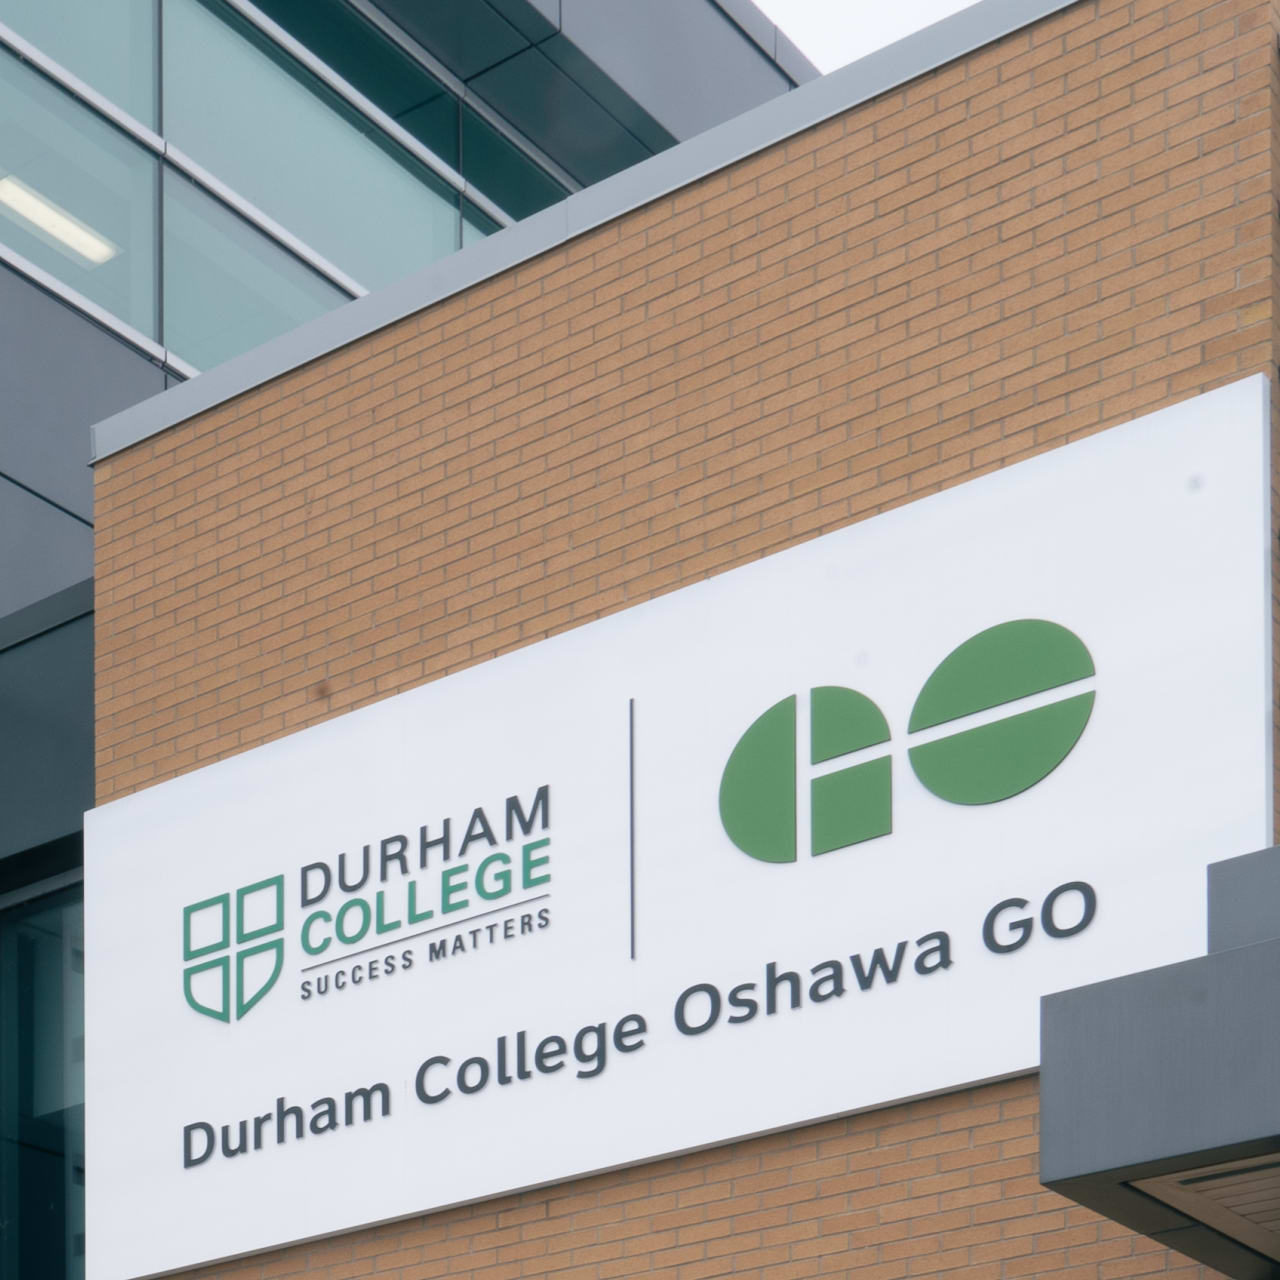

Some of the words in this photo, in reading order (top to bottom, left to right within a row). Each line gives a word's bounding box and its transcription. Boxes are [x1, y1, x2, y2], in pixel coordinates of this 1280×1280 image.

[301, 784, 549, 908] DURHAM
[301, 837, 551, 956] COLLEGE
[301, 950, 414, 1001] SUCCESS
[429, 908, 550, 962] MATTERS
[183, 1081, 392, 1169] Durham
[413, 1013, 648, 1105] College
[674, 930, 953, 1037] Oshawa
[981, 881, 1098, 956] GO
